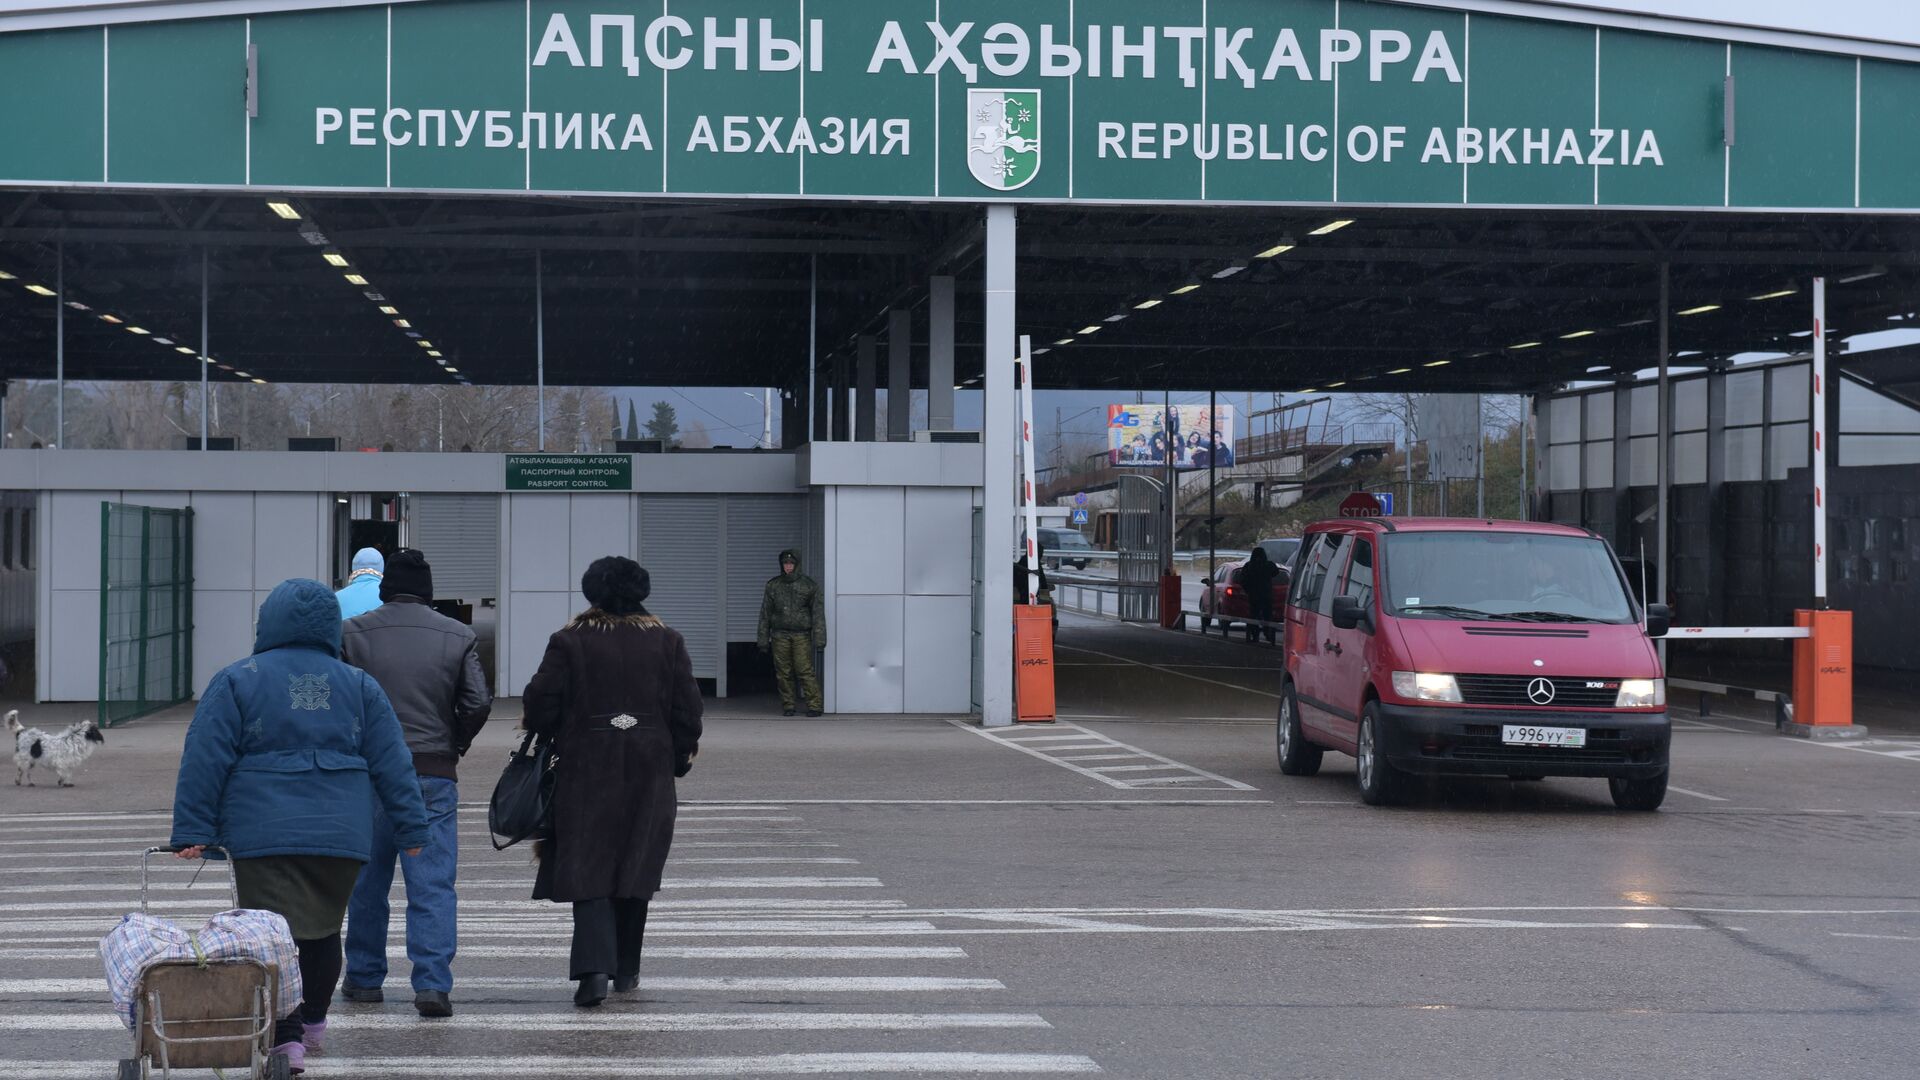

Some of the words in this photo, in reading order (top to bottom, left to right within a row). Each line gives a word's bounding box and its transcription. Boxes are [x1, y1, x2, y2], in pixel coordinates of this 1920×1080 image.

[315, 108, 653, 151] РЕСПУБЛИКА
[686, 115, 911, 155] АБХАЗИЯ
[1097, 122, 1329, 162] REPUBLIC
[1347, 125, 1407, 163] OF
[1420, 127, 1664, 166] ABKHAZIA
[1342, 507, 1379, 517] STOP
